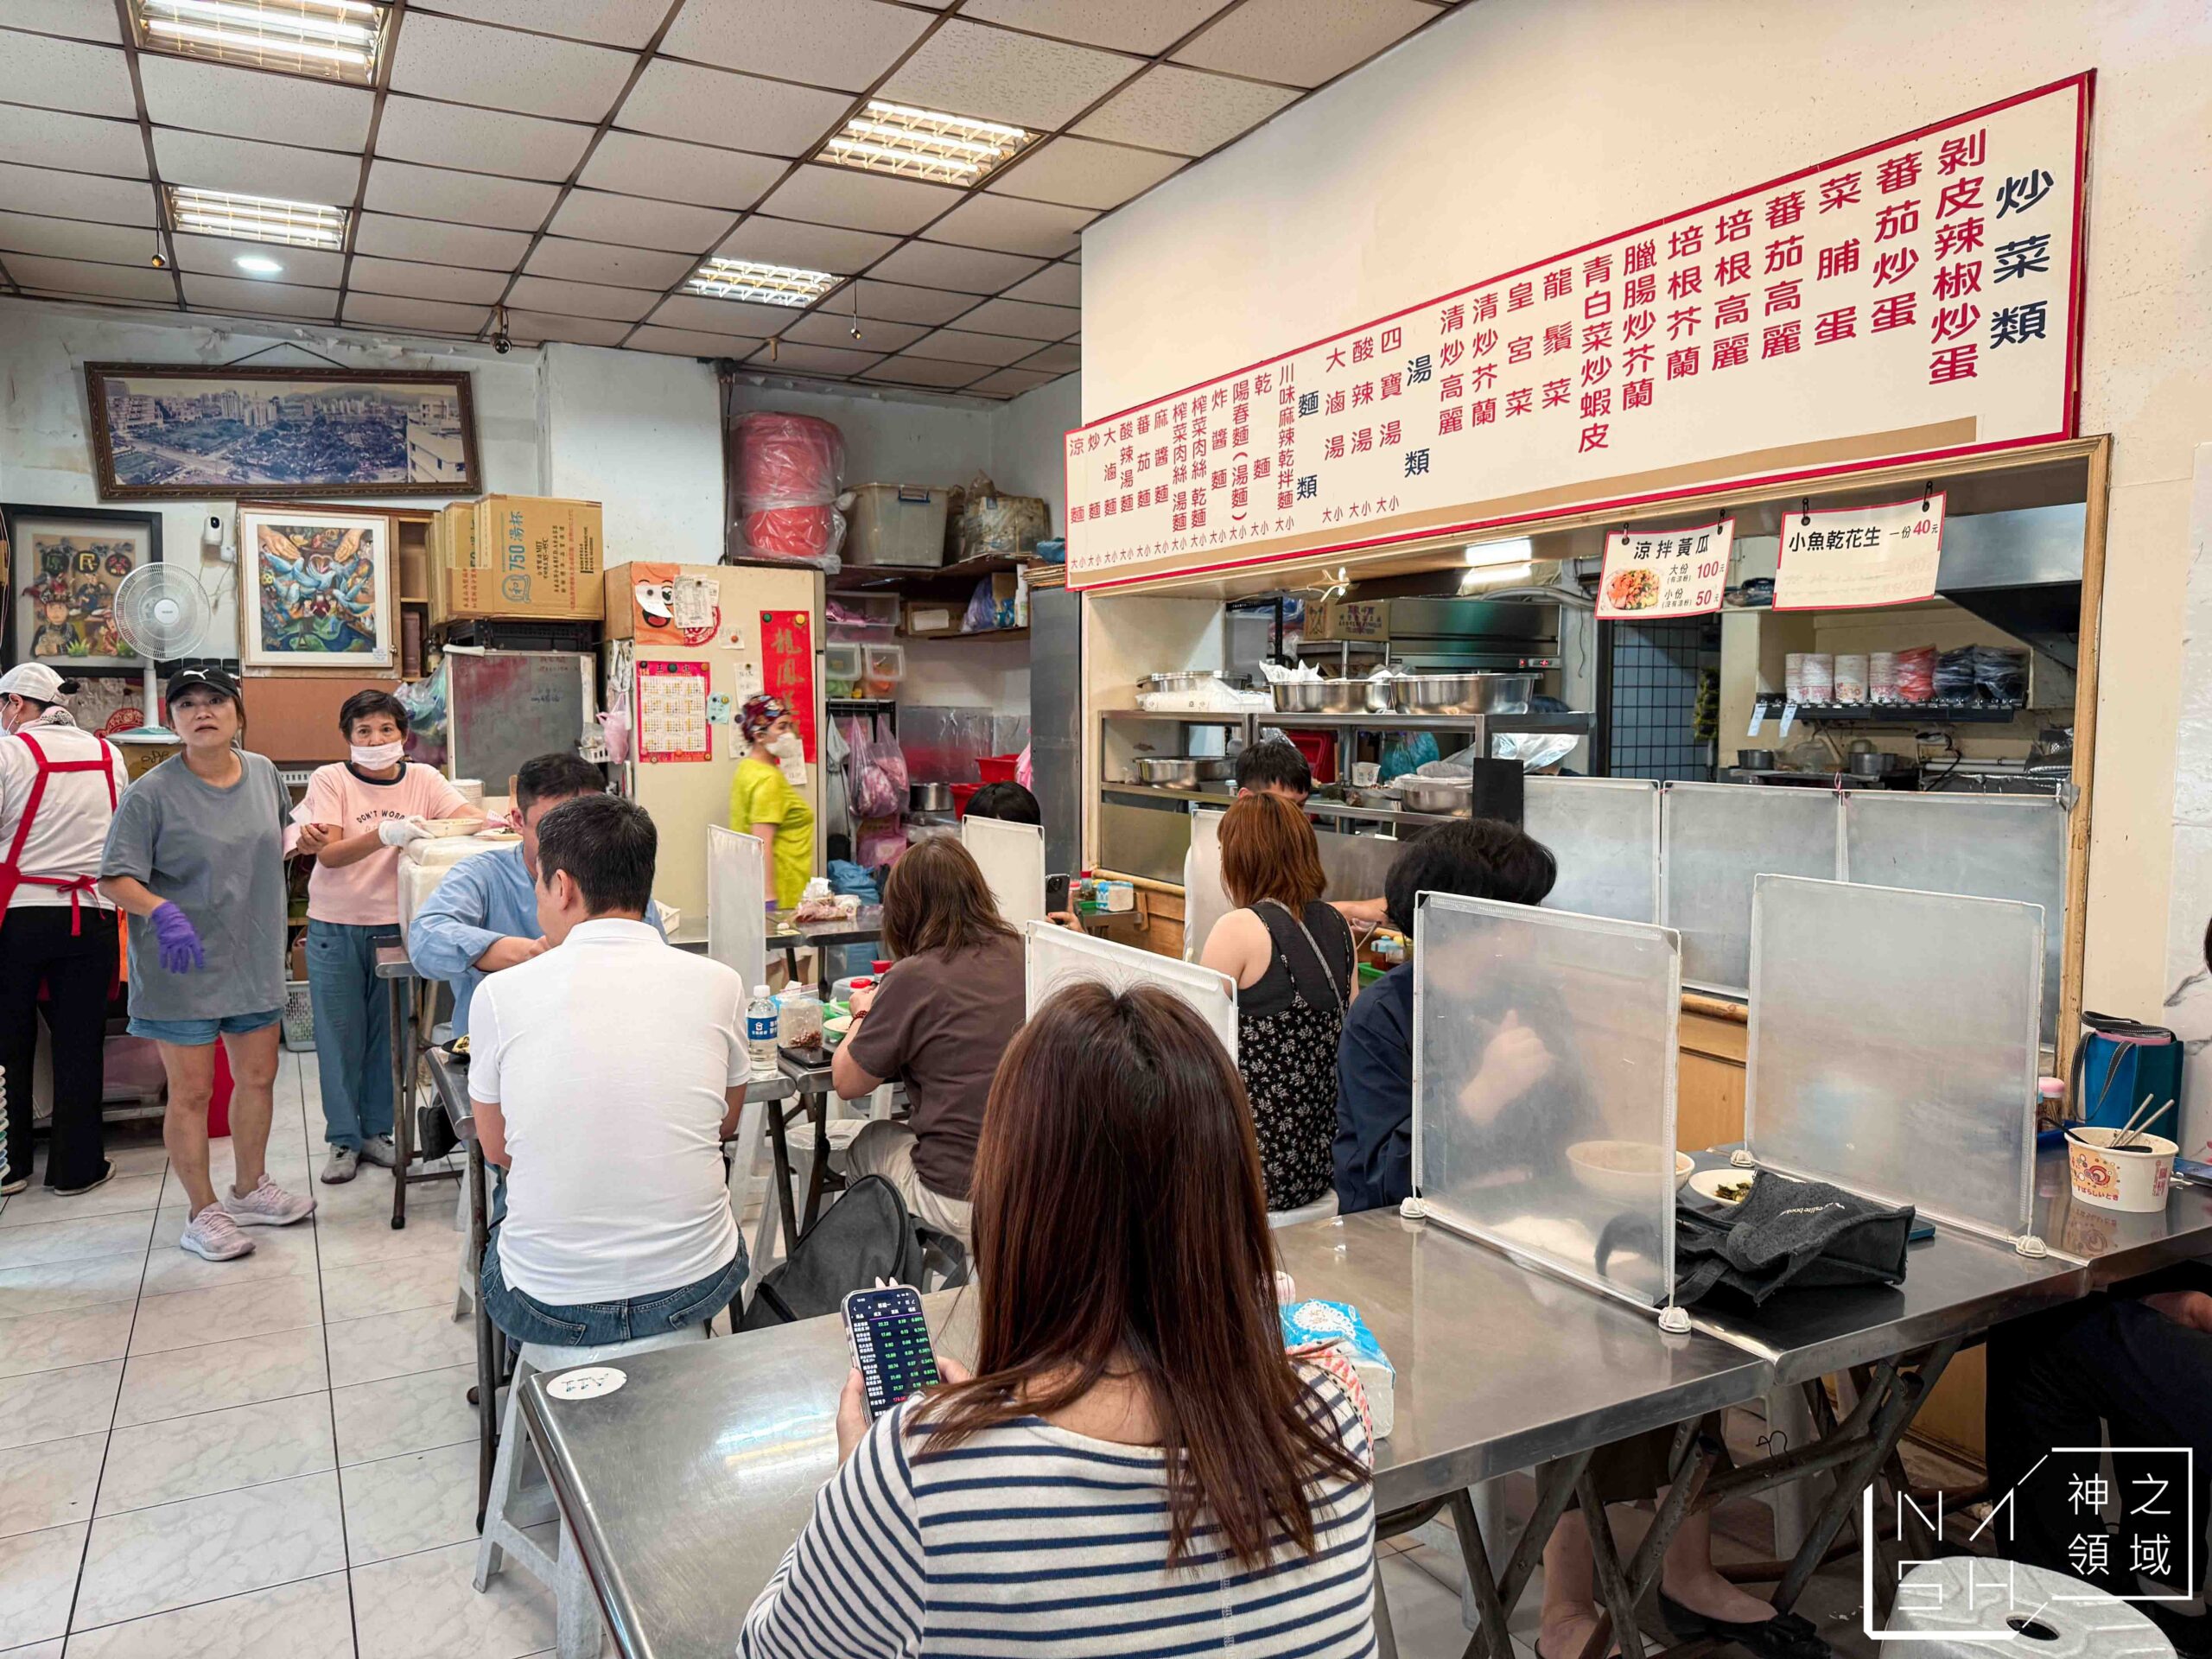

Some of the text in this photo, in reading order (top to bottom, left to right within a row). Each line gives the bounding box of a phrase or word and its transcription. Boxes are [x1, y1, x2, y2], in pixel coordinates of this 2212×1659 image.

[1712, 209, 1754, 372] 培根高麗
[1762, 191, 1805, 359] 蕃茄高麗
[1814, 171, 1862, 346] 菜脯蛋
[1871, 151, 1922, 334] 蕃茄炒蛋
[1989, 168, 2055, 350] 炒菜類
[1471, 292, 1499, 427] 清炒芥蘭
[1506, 281, 1535, 418] 皇宮菜
[1541, 267, 1573, 409] 龍鬚菜
[1578, 255, 1612, 454] 青白菜炒蝦皮
[1667, 225, 1704, 382] 培根芥蘭
[1253, 373, 1272, 480] 乾麵
[1325, 347, 1347, 461] 大滷湯
[1351, 337, 1375, 454] 酸辣湯
[1380, 326, 1402, 445] 四寶湯
[1404, 354, 1433, 478] 湯類
[1439, 304, 1465, 435] 清炒高麗
[1070, 437, 1085, 524] 涼麵
[1087, 434, 1102, 521] 炒麵
[1103, 428, 1117, 517] 大滷麵
[1119, 423, 1134, 512] 酸辣湯麵
[1137, 415, 1151, 509] 蕃茄麵
[1154, 409, 1169, 504] 麻醬麵
[1173, 403, 1187, 531] 榨菜肉絲湯麵
[1191, 395, 1207, 528] 榨菜肉絲乾麵
[1211, 389, 1228, 490] 炸醬麵
[1277, 362, 1295, 511] 川味麻辣乾拌麵
[1297, 390, 1319, 501] 麵類
[509, 543, 526, 572] 750
[1633, 534, 1710, 560] 涼拌黃瓜
[1664, 588, 1683, 601] 小份
[1669, 563, 1688, 575] 大份
[1789, 526, 1881, 552] 小魚乾花生
[356, 810, 378, 823] DON'T
